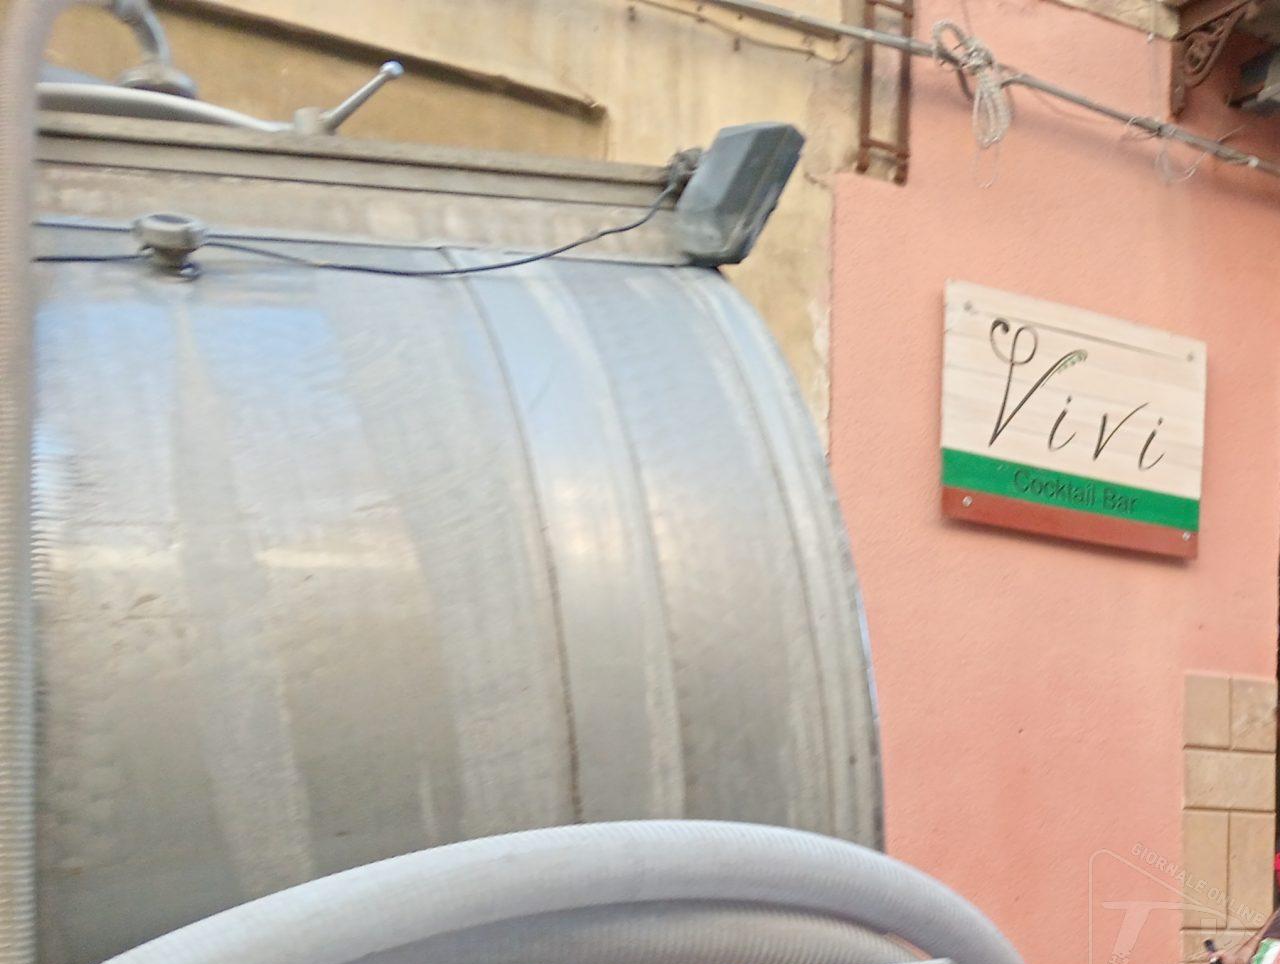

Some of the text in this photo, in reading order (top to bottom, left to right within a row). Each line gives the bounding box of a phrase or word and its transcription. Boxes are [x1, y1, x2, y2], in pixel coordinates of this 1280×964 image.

[989, 317, 1166, 471] Vivi
[1013, 469, 1138, 514] Cocktail Bar
